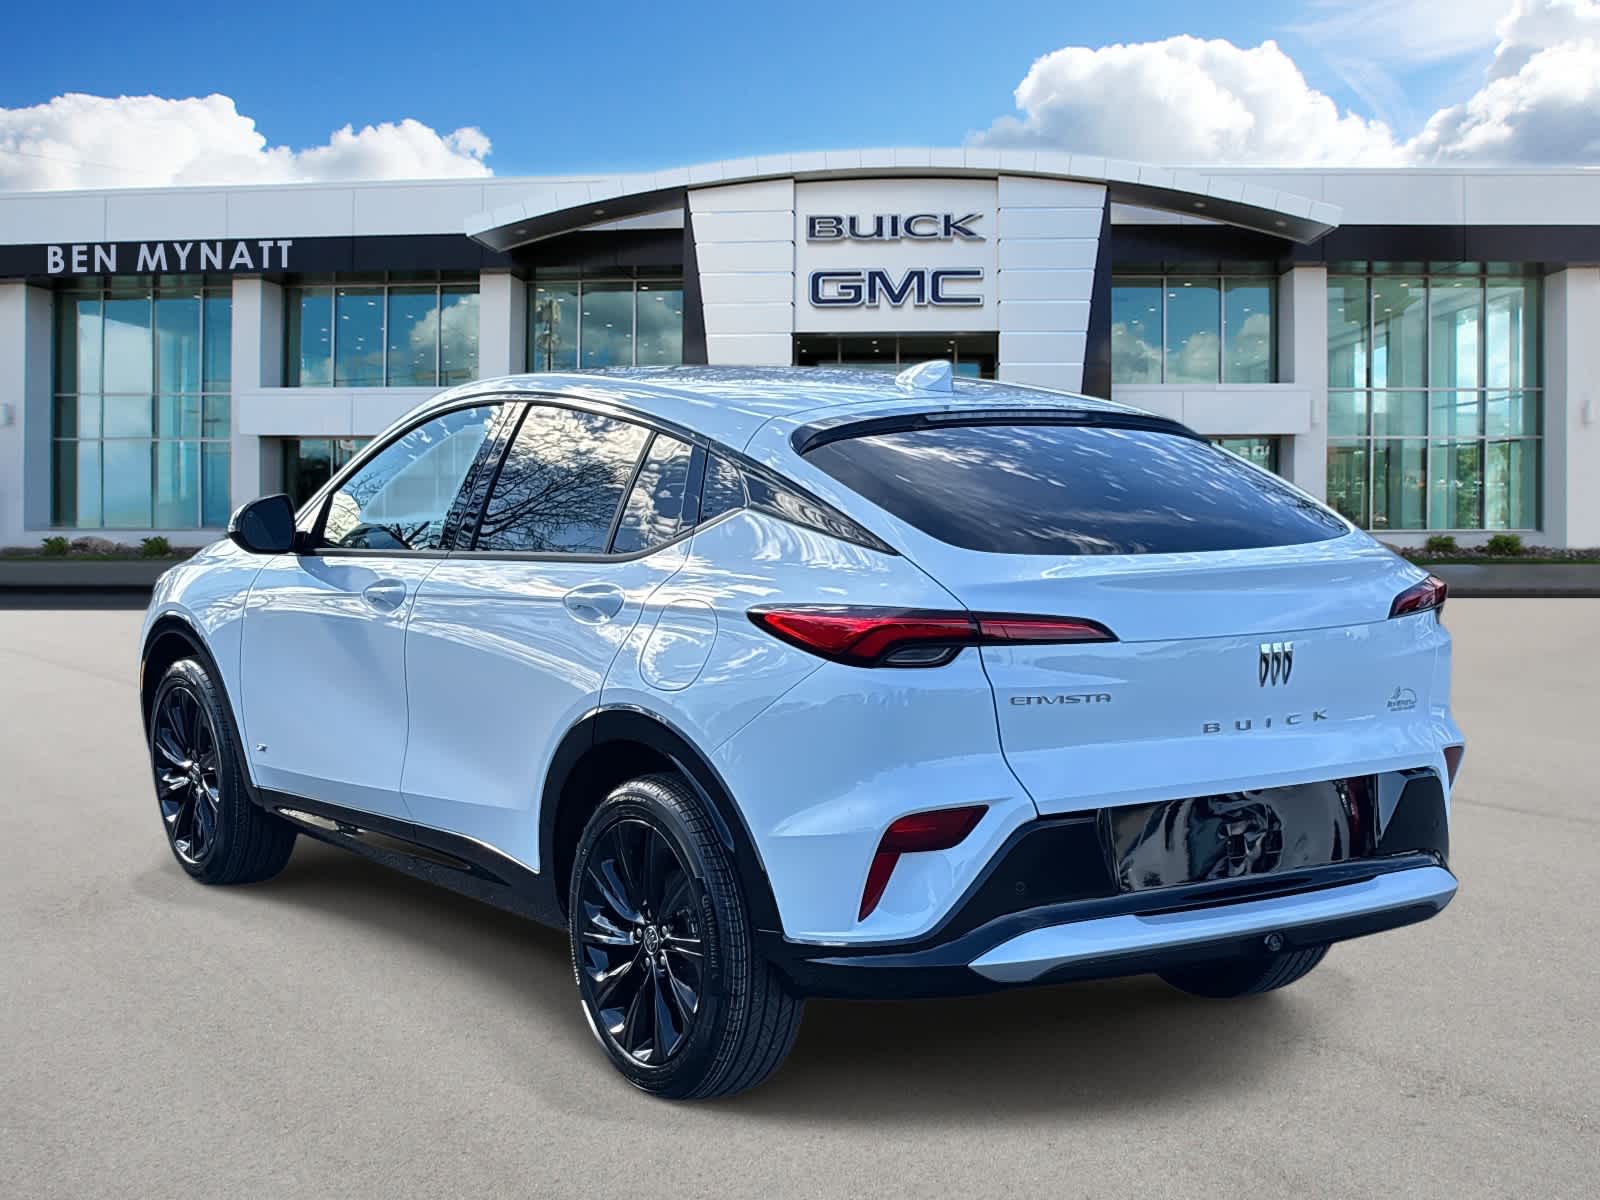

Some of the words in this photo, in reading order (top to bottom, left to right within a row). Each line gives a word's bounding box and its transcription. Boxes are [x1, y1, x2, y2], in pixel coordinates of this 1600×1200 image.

[806, 213, 986, 242] BUICK
[47, 244, 117, 274] BEN
[136, 240, 293, 272] MYNATT
[808, 267, 985, 308] GMC
[1010, 692, 1112, 706] ENVISTA
[1202, 708, 1328, 734] BUICK
